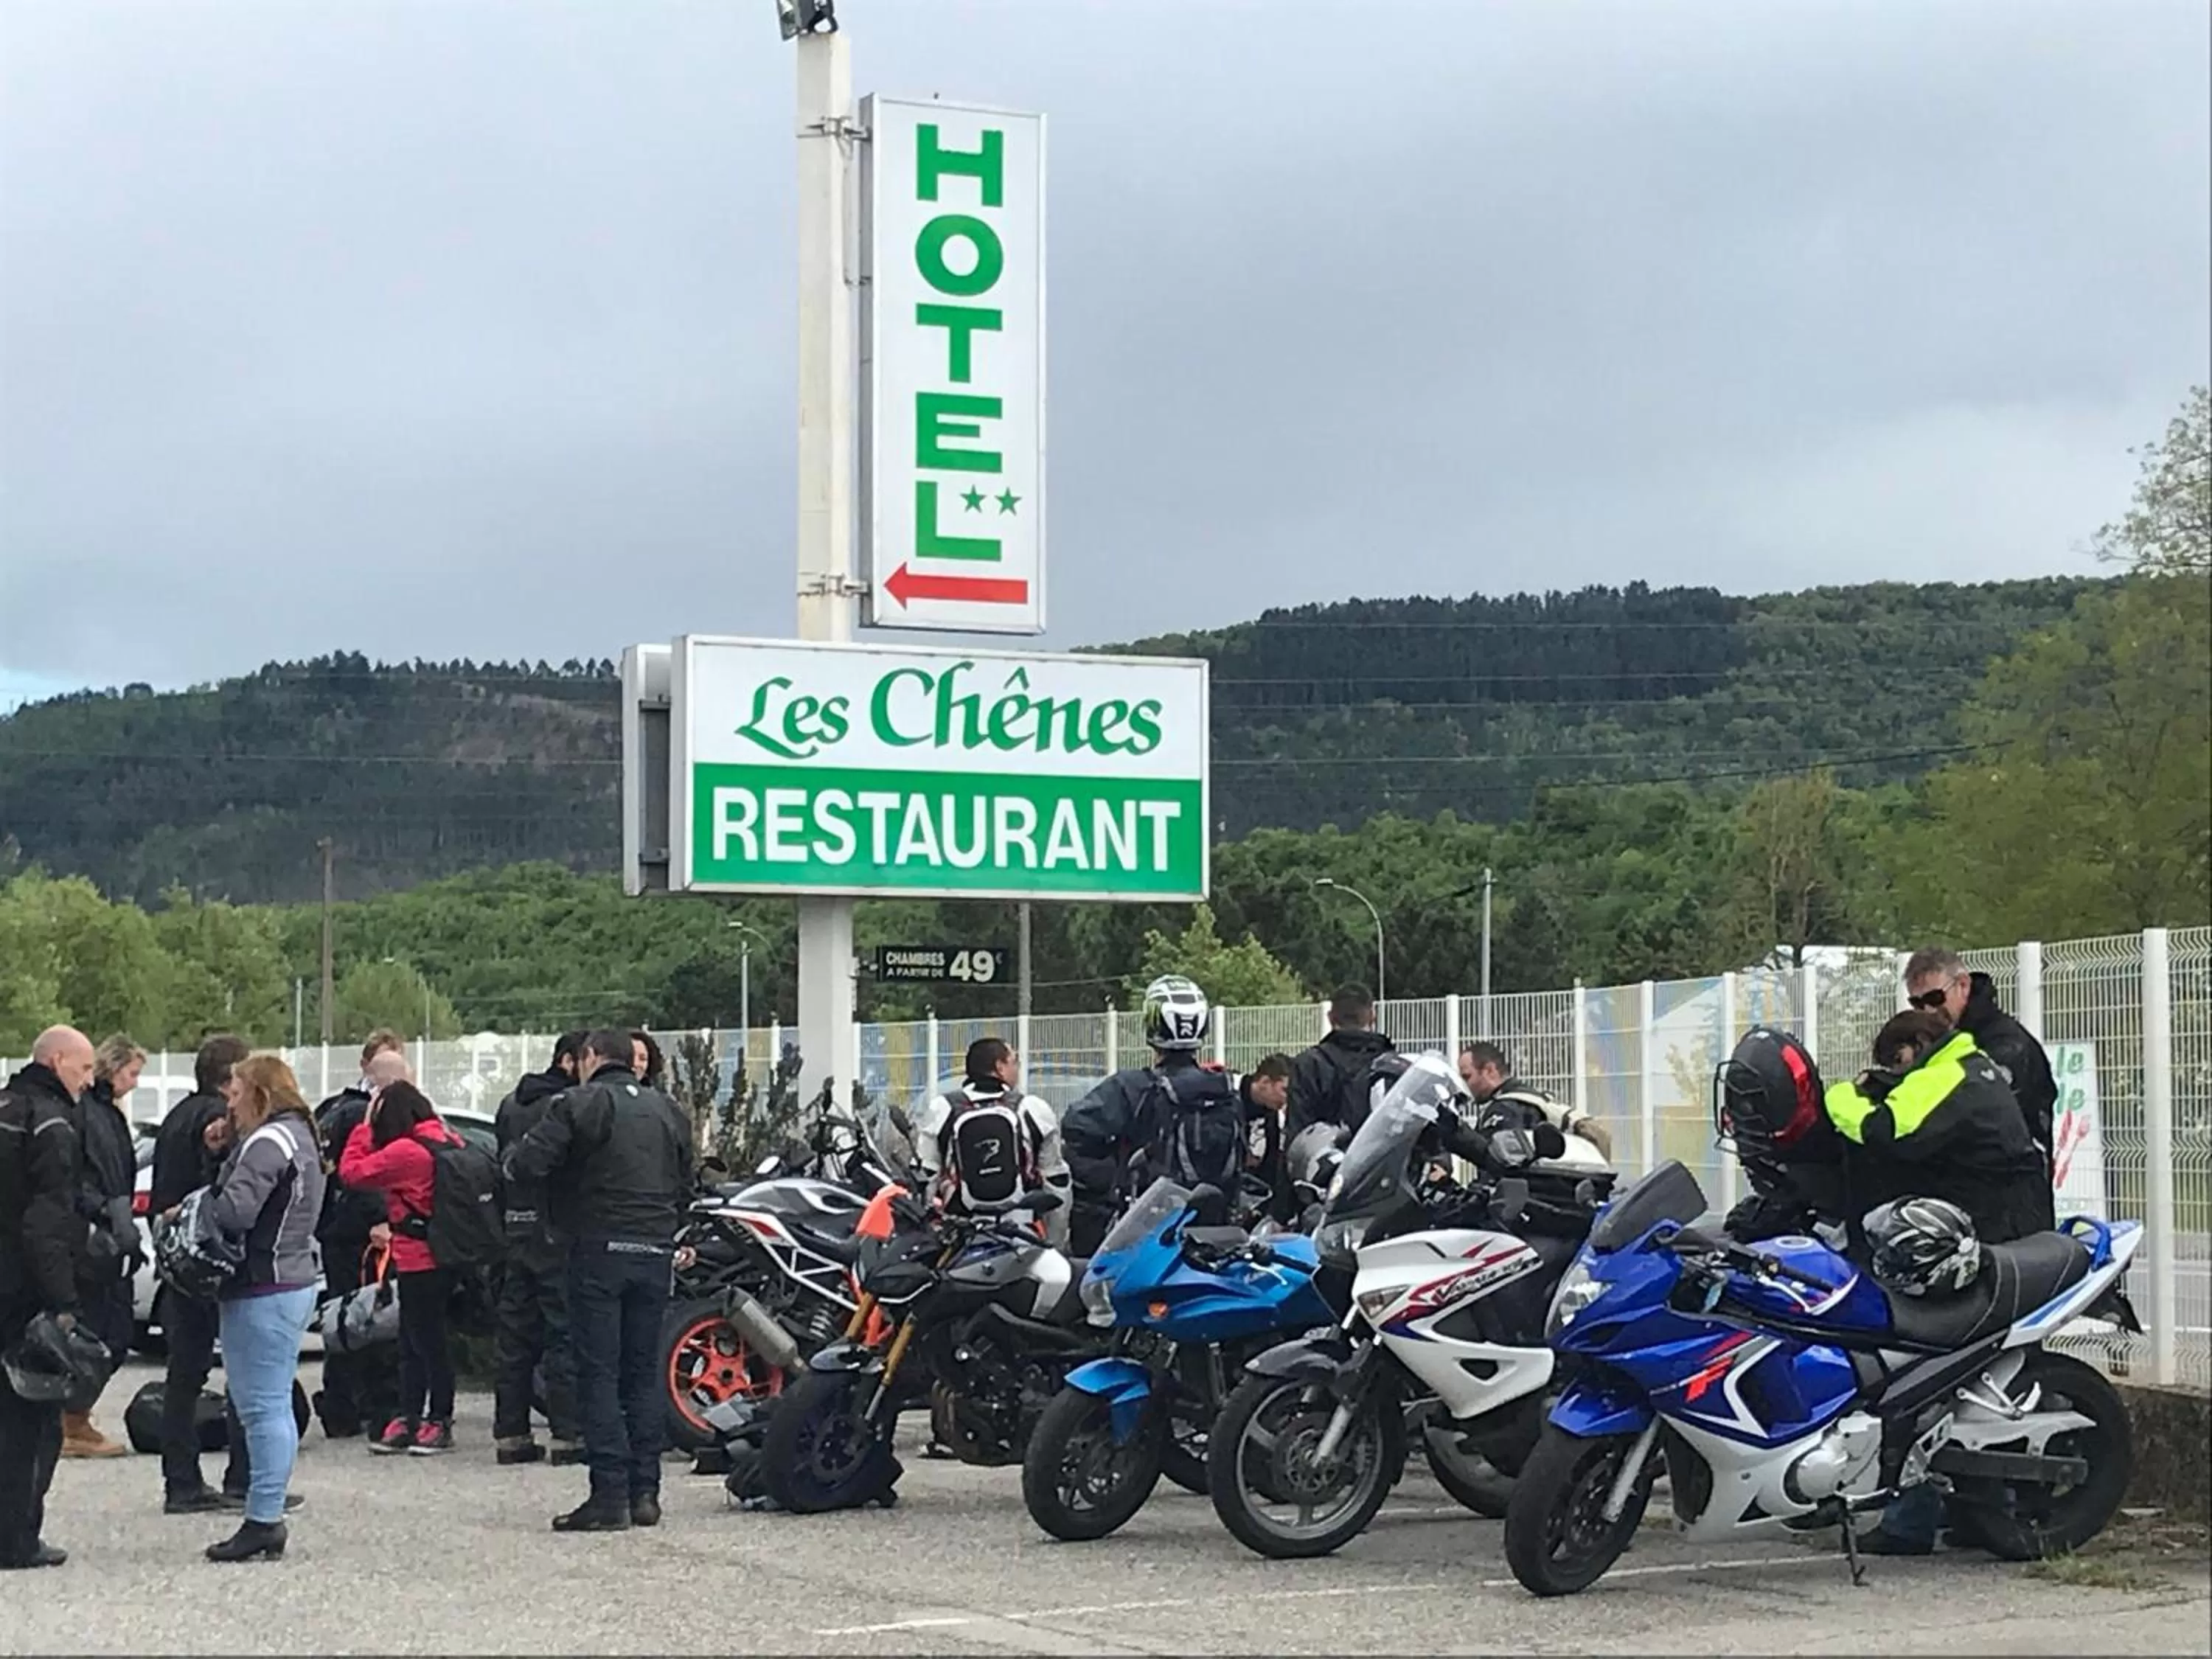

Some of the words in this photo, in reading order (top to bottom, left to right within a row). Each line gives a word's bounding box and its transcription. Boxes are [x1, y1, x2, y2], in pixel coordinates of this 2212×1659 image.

[915, 123, 1003, 561] HOTEL
[734, 676, 849, 759] Les
[871, 661, 1163, 757] Chênes
[712, 786, 1181, 872] RESTAURANT
[886, 951, 945, 965] CHAMBRES
